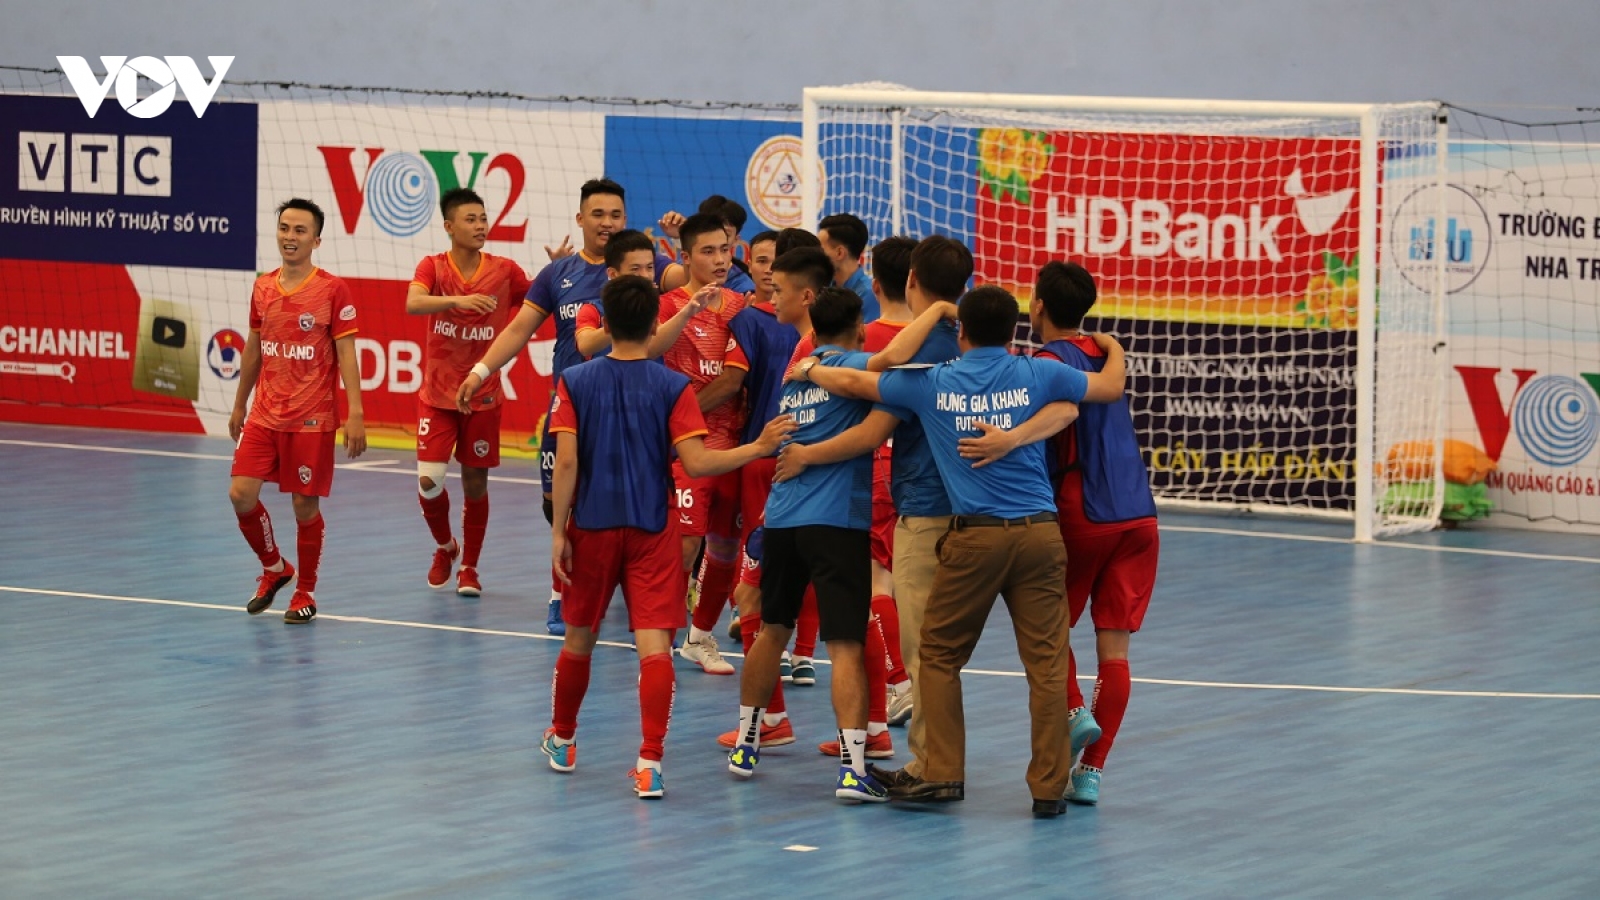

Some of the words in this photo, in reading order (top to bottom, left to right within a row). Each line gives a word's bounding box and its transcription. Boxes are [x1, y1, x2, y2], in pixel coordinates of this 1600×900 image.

[28, 142, 160, 186] VTC
[54, 207, 91, 228] HÌNH
[120, 209, 170, 233] THUẬT
[173, 211, 194, 233] SỐ
[199, 216, 229, 234] VTC
[1046, 195, 1284, 263] HDBank
[1498, 208, 1585, 238] TRƯỜNG
[1525, 255, 1568, 279] NHA
[0, 326, 129, 359] CHANNEL
[434, 320, 457, 338] HGK
[462, 324, 494, 341] LAND
[260, 341, 279, 357] HGK
[283, 343, 314, 361] LAND
[970, 392, 989, 413] GIA
[991, 387, 1030, 411] KHANG
[1507, 467, 1553, 496] QUẢNG
[1556, 471, 1583, 495] CÁO
[1585, 477, 1594, 496] &
[676, 488, 693, 508] 16
